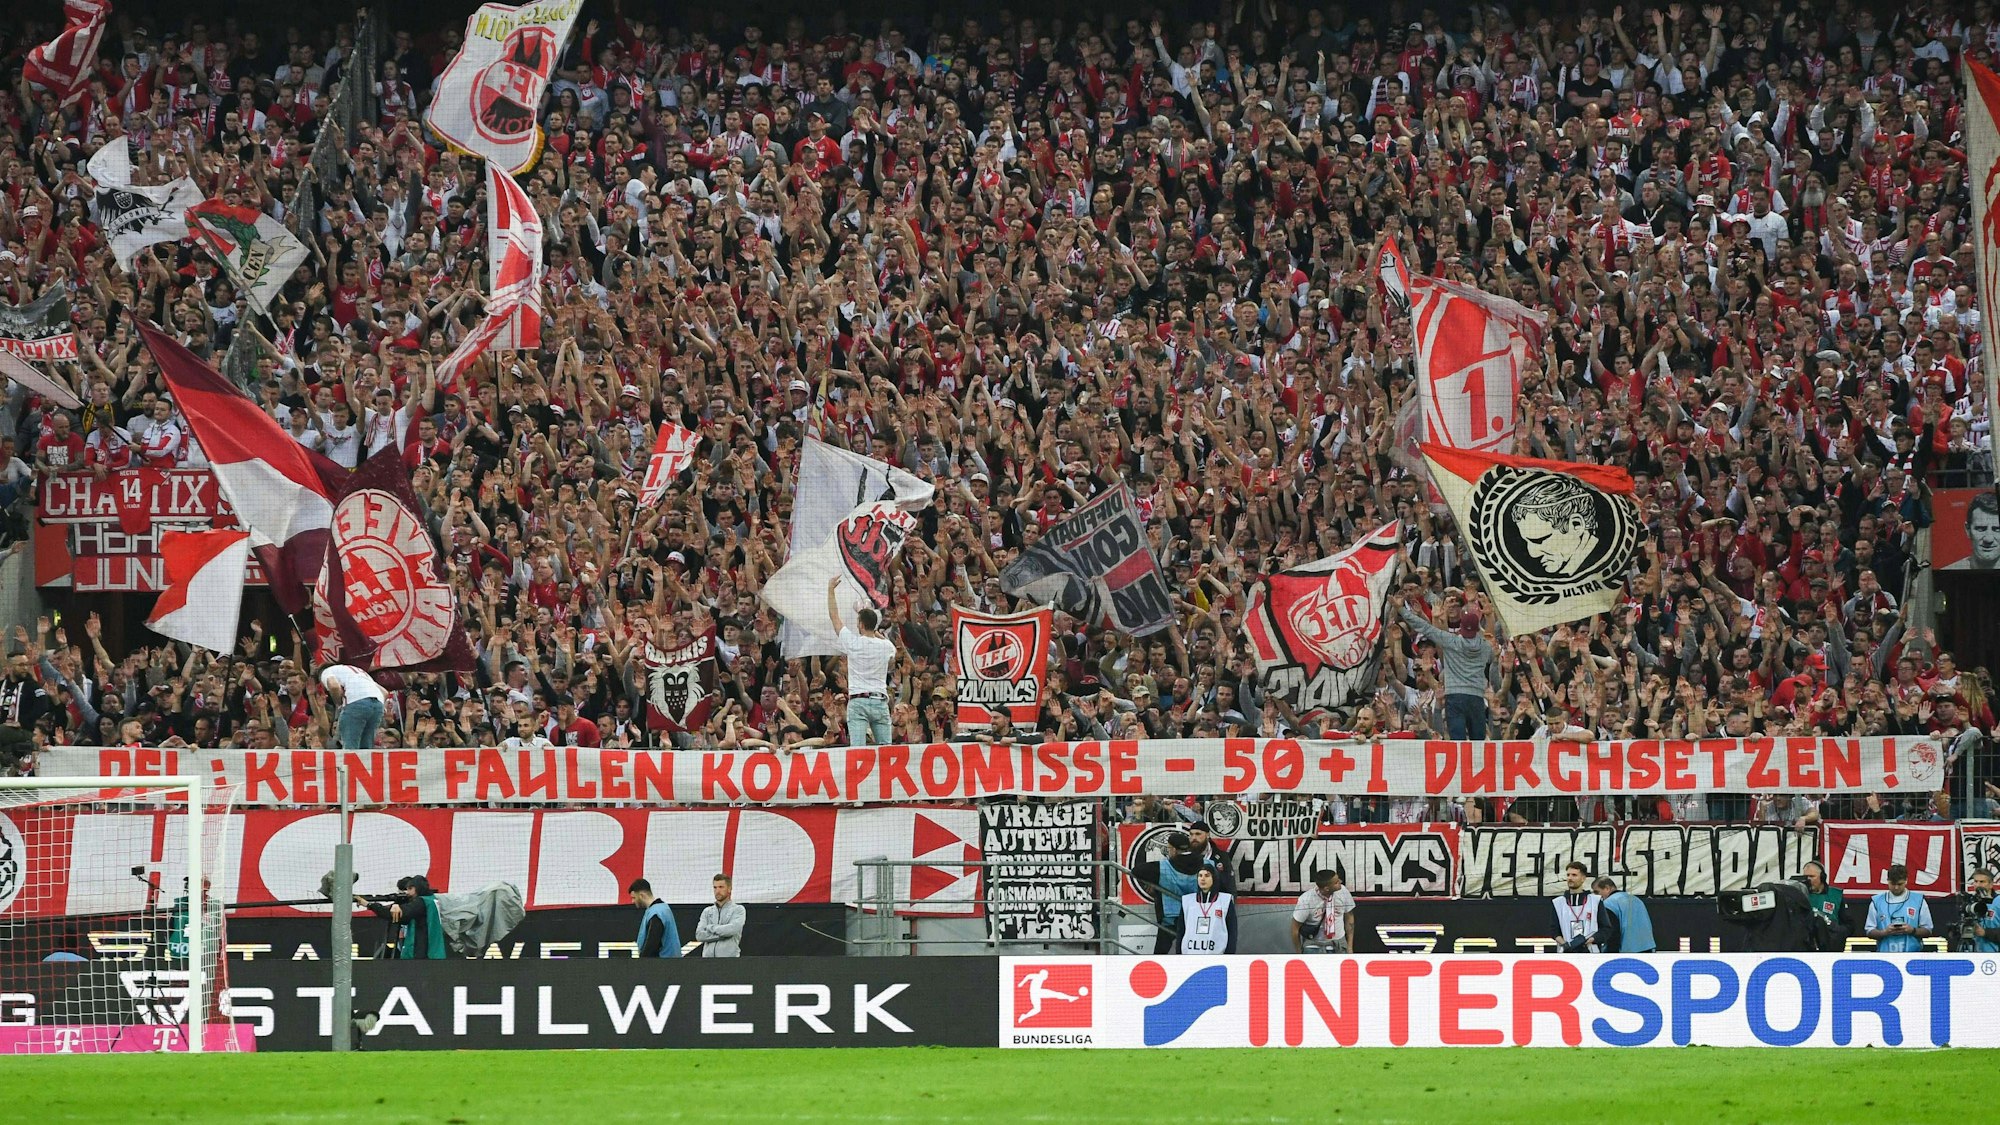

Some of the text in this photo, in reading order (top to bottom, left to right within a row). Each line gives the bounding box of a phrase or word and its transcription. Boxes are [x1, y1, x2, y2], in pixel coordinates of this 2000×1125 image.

[120, 478, 143, 503] 14
[1561, 581, 1603, 598] ULTRA
[981, 645, 1012, 667] 1.FC
[958, 679, 1036, 702] COLONIACS
[245, 750, 419, 803] KEINE
[444, 748, 674, 800] FAULEN
[701, 740, 1143, 801] KOMPROMISSE
[1424, 738, 1862, 793] DURCHSETZEN
[981, 802, 1094, 827] VIRAGE
[984, 827, 1092, 851] AUTEUIL
[66, 809, 981, 916] HORDE
[985, 853, 1077, 877] TRIBUNE
[1231, 839, 1447, 893] COLONIACS
[1187, 939, 1215, 951] CLUB
[222, 984, 915, 1037] STAHLWERK
[1249, 957, 1974, 1047] INTERSPORT
[1013, 1035, 1092, 1044] BUNDESLIGA
